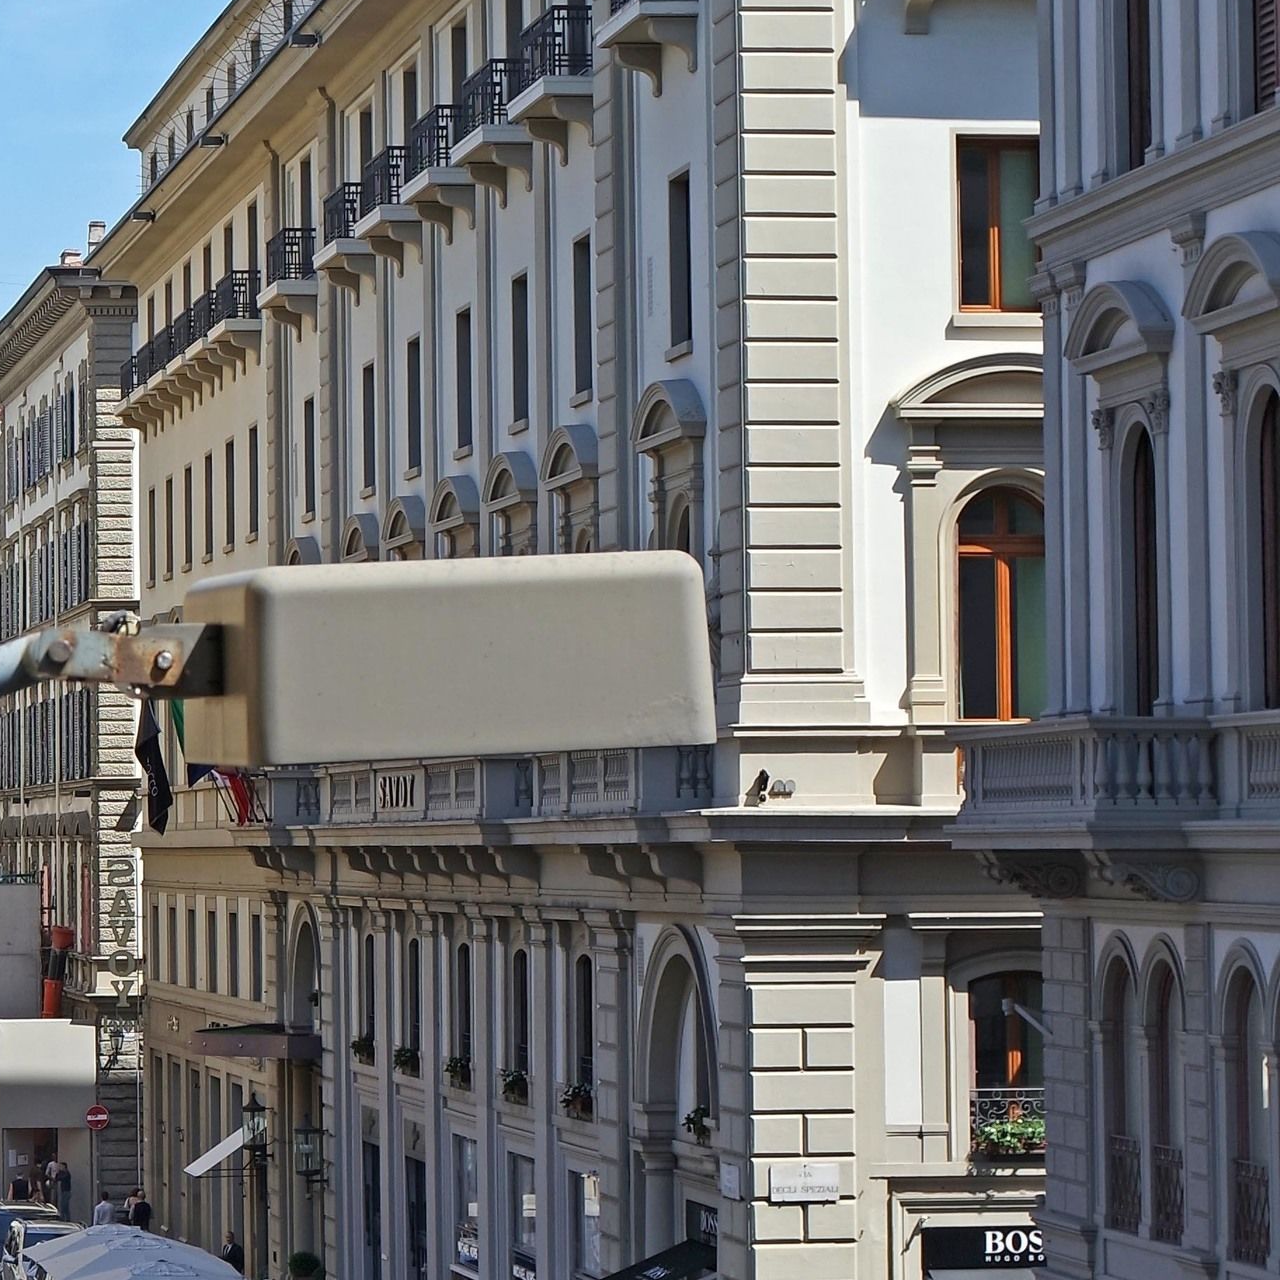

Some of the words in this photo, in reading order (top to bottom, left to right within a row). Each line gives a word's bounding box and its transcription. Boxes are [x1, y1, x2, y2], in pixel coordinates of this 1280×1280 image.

[378, 774, 415, 809] SAVOY
[107, 859, 136, 1007] SAVOY
[985, 1254, 1021, 1262] HUGO
